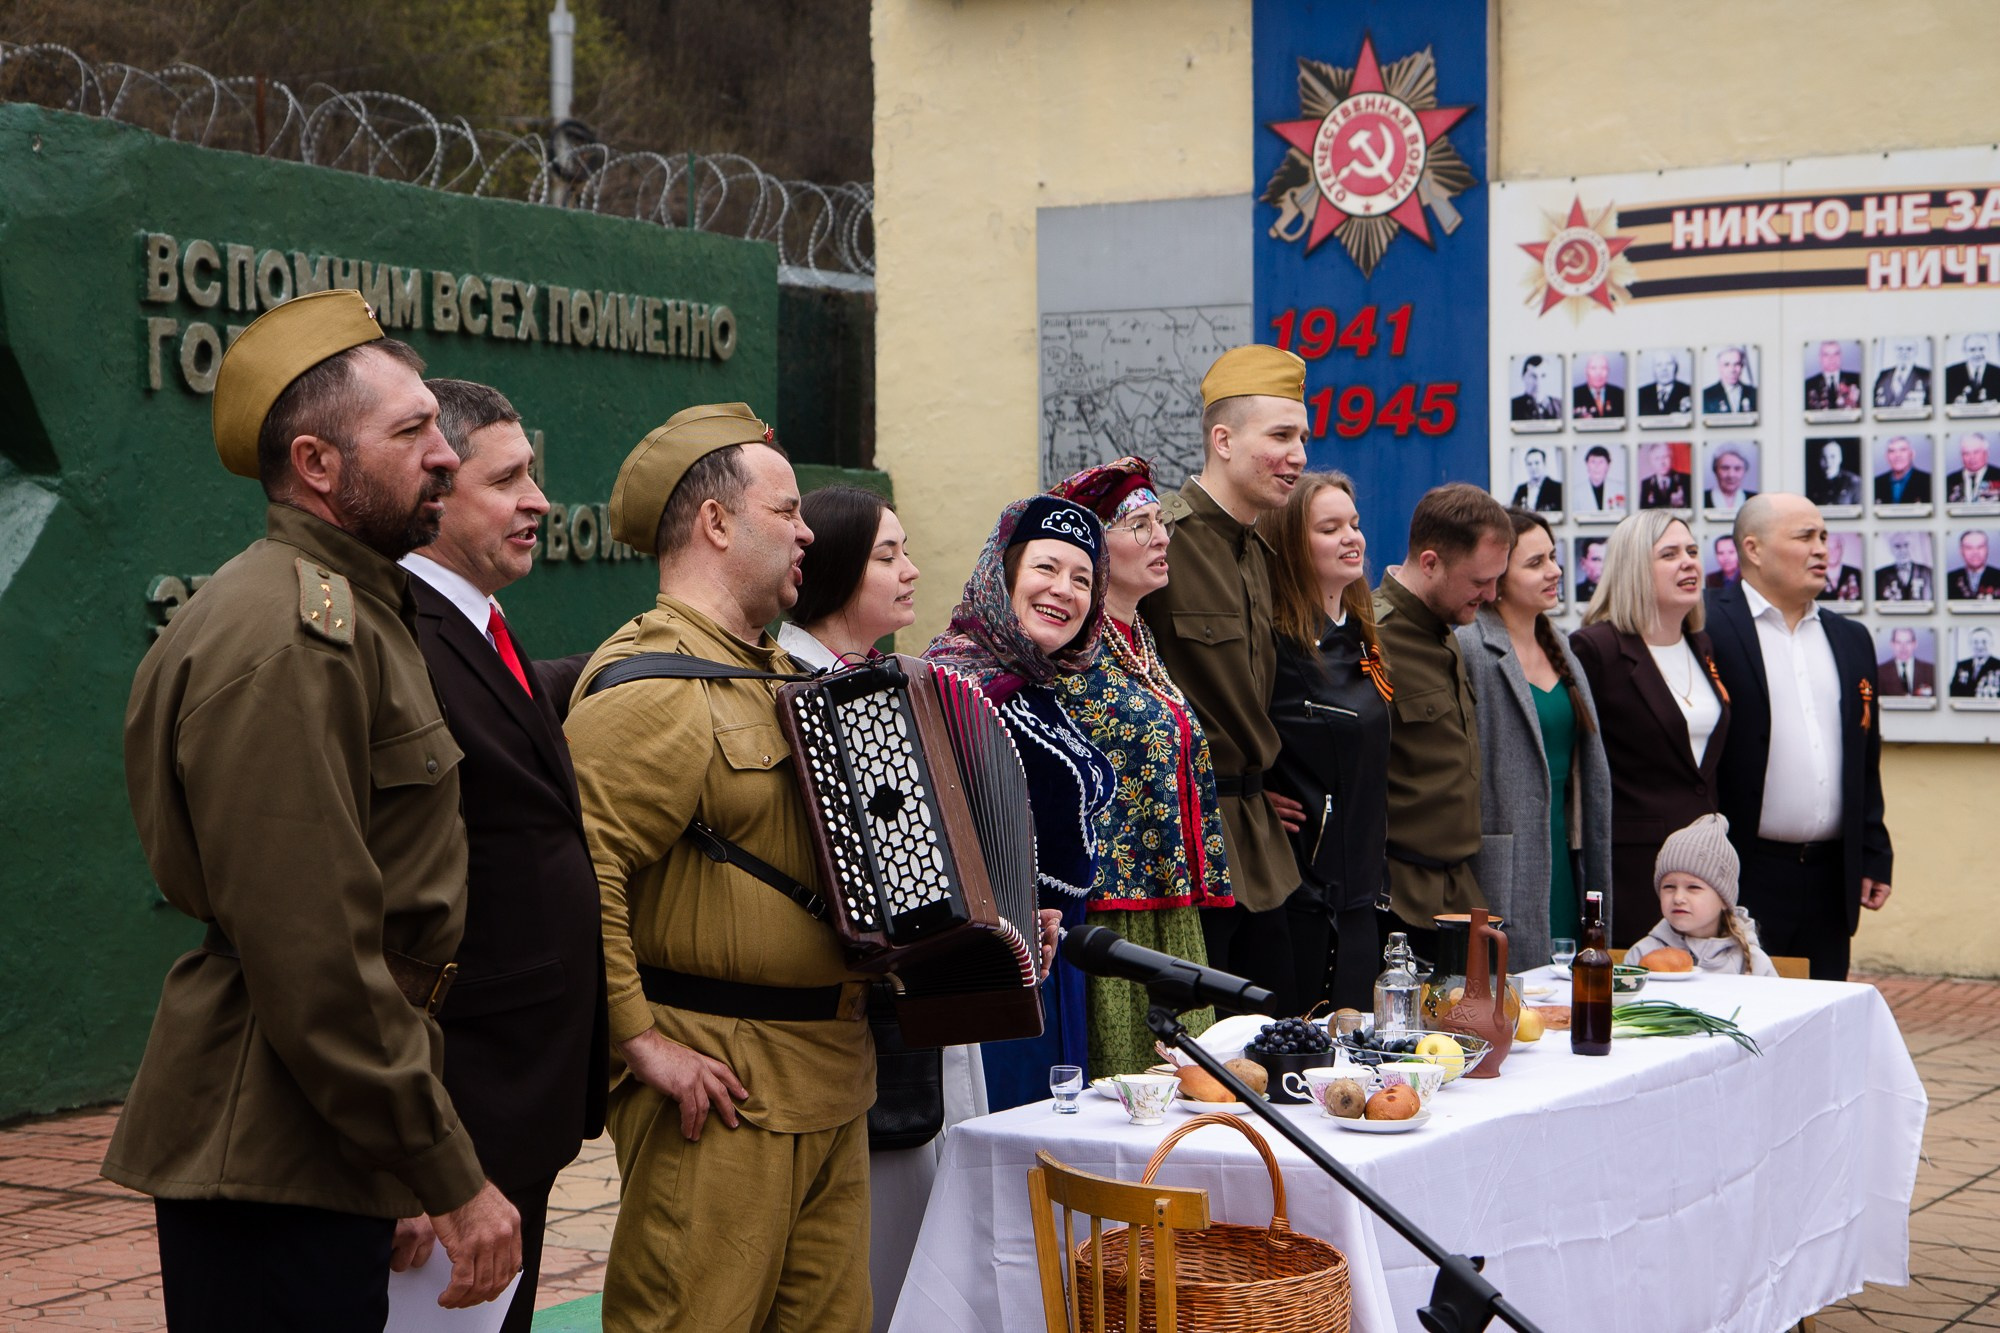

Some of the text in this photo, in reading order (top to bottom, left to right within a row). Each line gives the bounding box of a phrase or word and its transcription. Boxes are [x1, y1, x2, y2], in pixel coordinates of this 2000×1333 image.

[1317, 97, 1412, 202] ОТЕЧЕСТВЕННАЯ
[1672, 199, 1851, 250] НИКТО
[1862, 192, 1931, 237] НЕ
[433, 270, 540, 340] ВСЕХ
[549, 284, 737, 360] ПОИМЕННО
[1271, 303, 1413, 360] 1941
[1309, 382, 1460, 438] 1945
